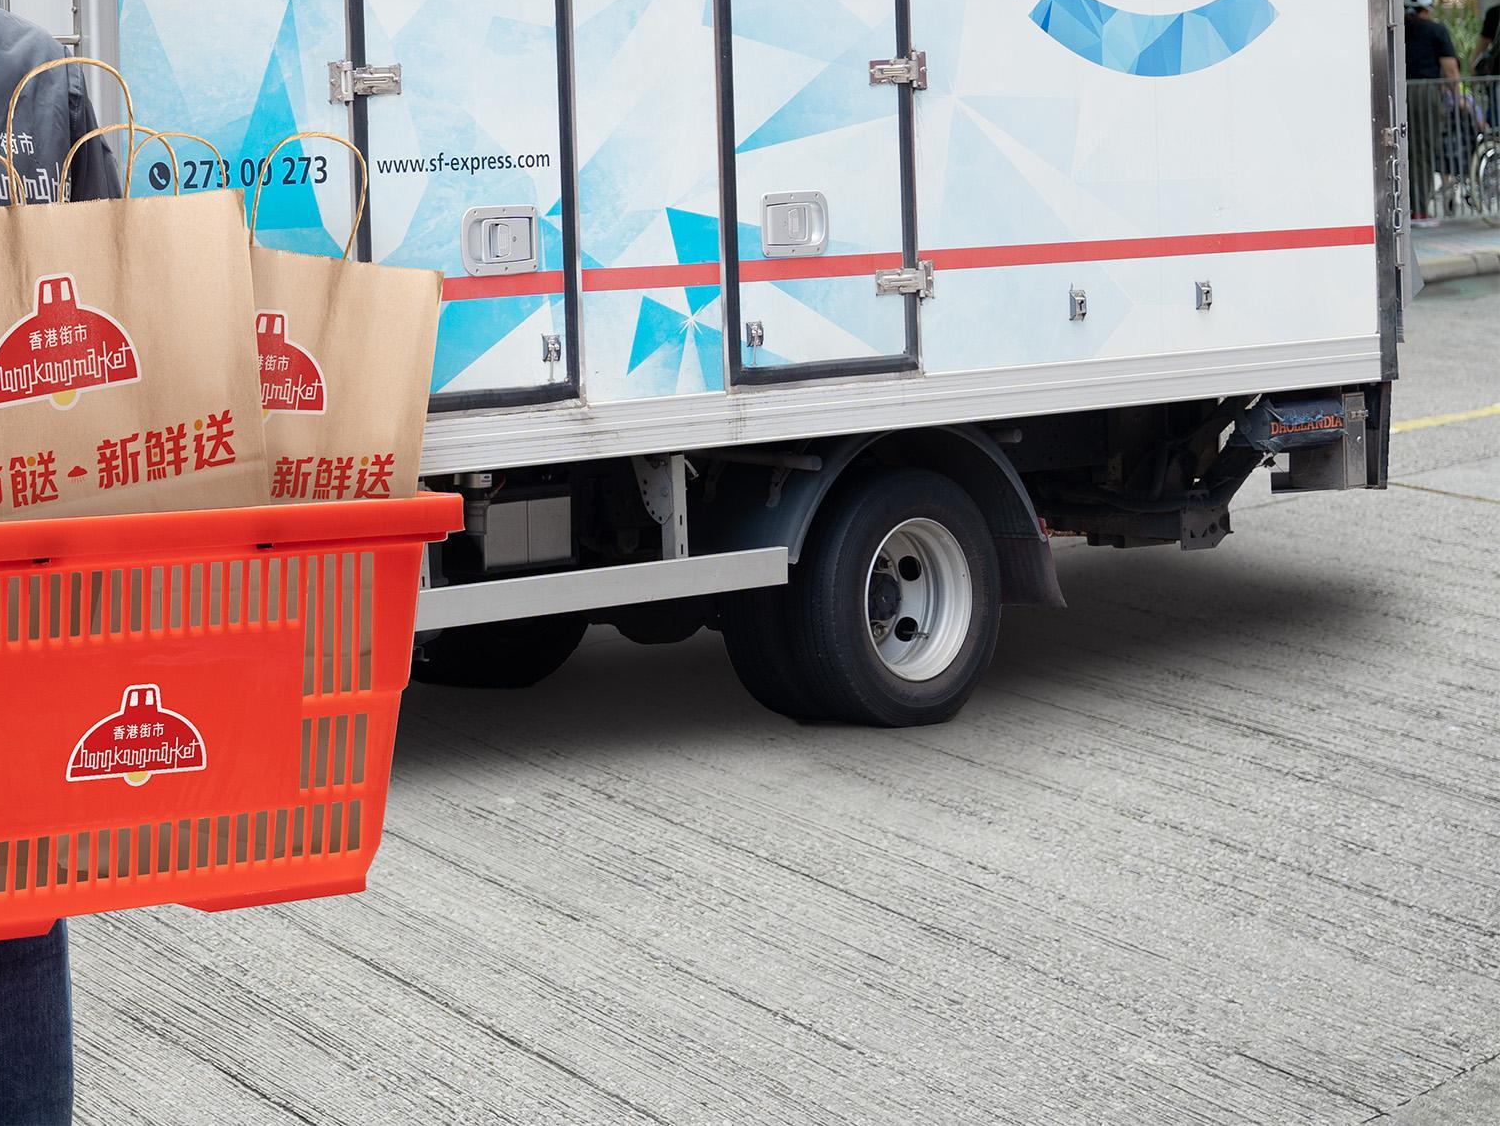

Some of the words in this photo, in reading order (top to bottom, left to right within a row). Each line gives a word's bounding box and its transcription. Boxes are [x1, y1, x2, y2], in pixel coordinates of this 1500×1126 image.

[183, 160, 230, 189] 273
[240, 158, 272, 187] 00
[282, 156, 327, 185] 273
[377, 152, 551, 175] www.sf-express.com
[28, 324, 88, 351] 香港街市
[96, 409, 237, 490] 新鮮送
[270, 453, 395, 500] 新鮮送
[112, 721, 165, 741] 香港街市
